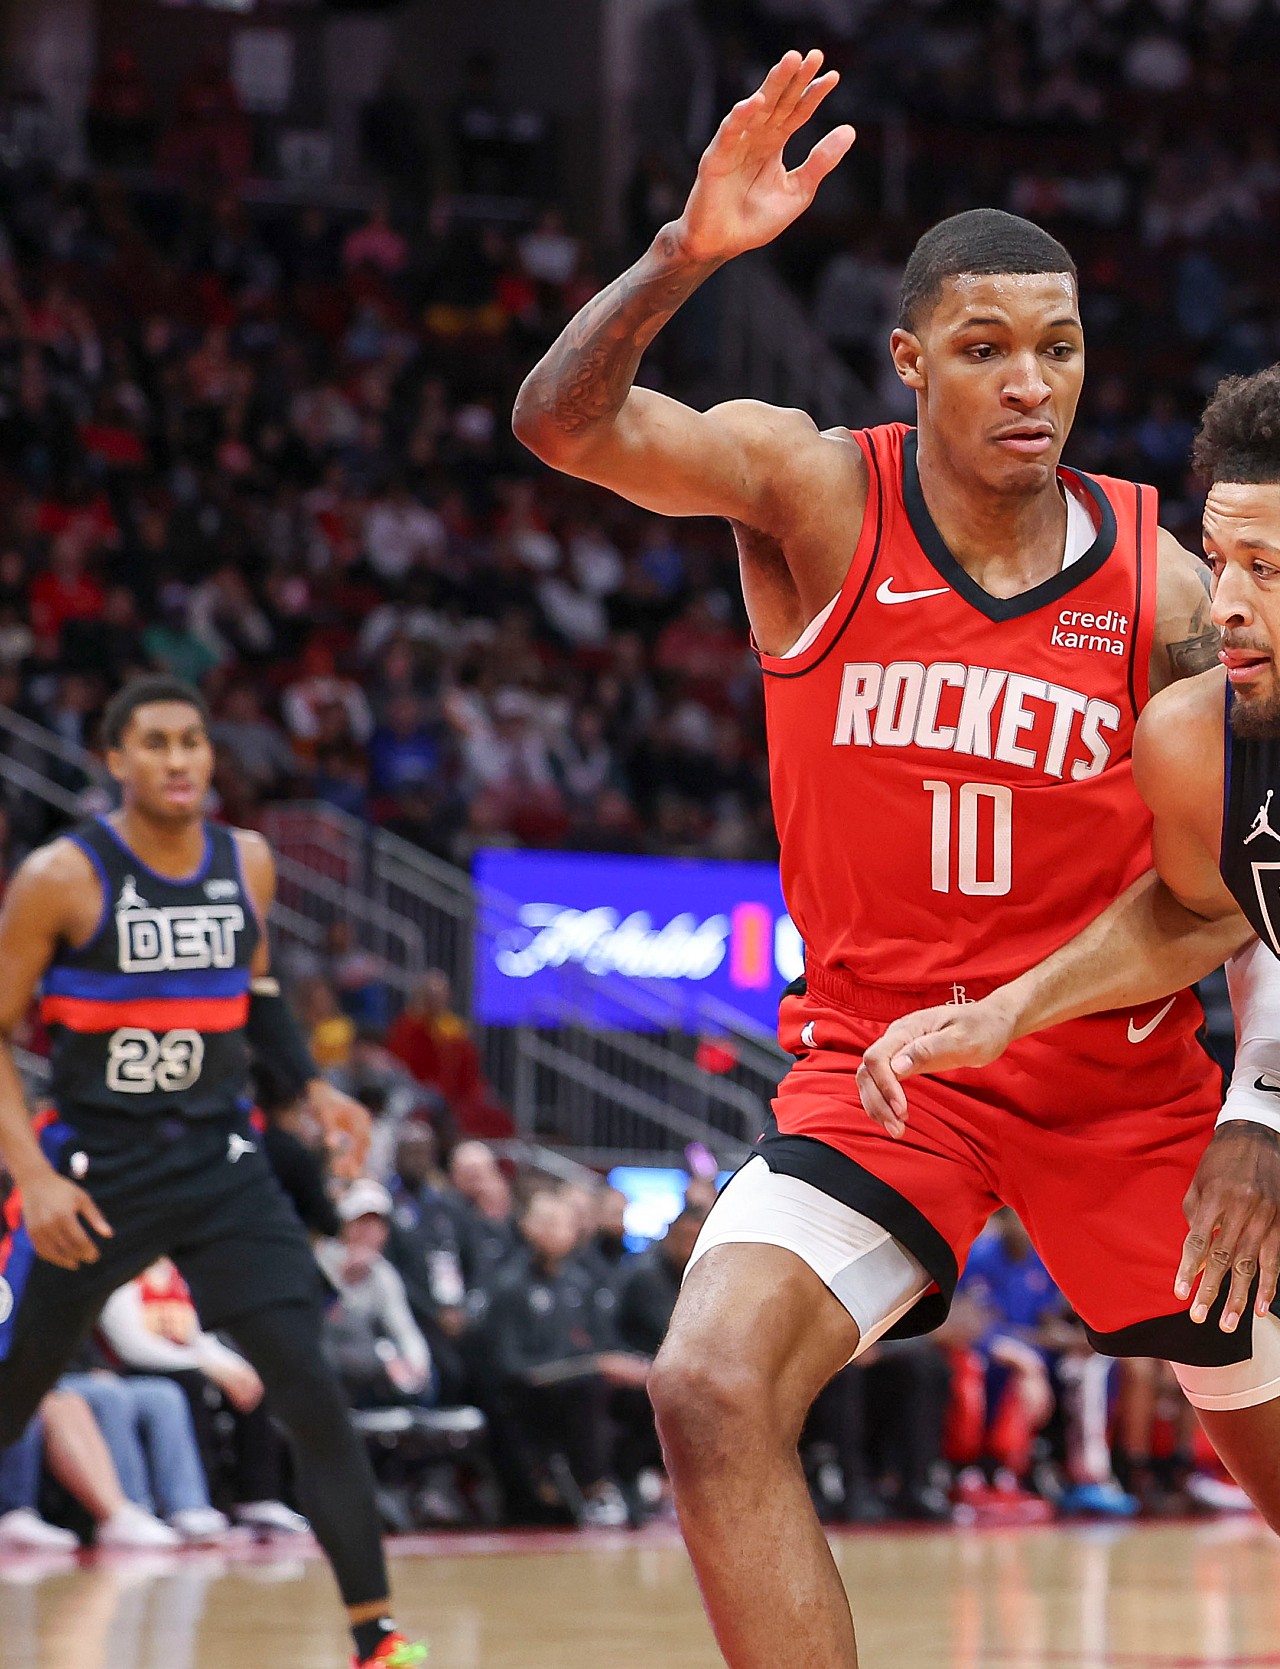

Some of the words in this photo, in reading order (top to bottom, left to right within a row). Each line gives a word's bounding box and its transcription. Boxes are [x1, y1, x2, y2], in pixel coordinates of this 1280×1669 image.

[1051, 626, 1125, 656] karma
[1059, 609, 1128, 635] credit
[832, 661, 1121, 781] ROCKETS
[922, 780, 1013, 896] 10
[115, 904, 245, 974] DET
[105, 1027, 205, 1094] 23
